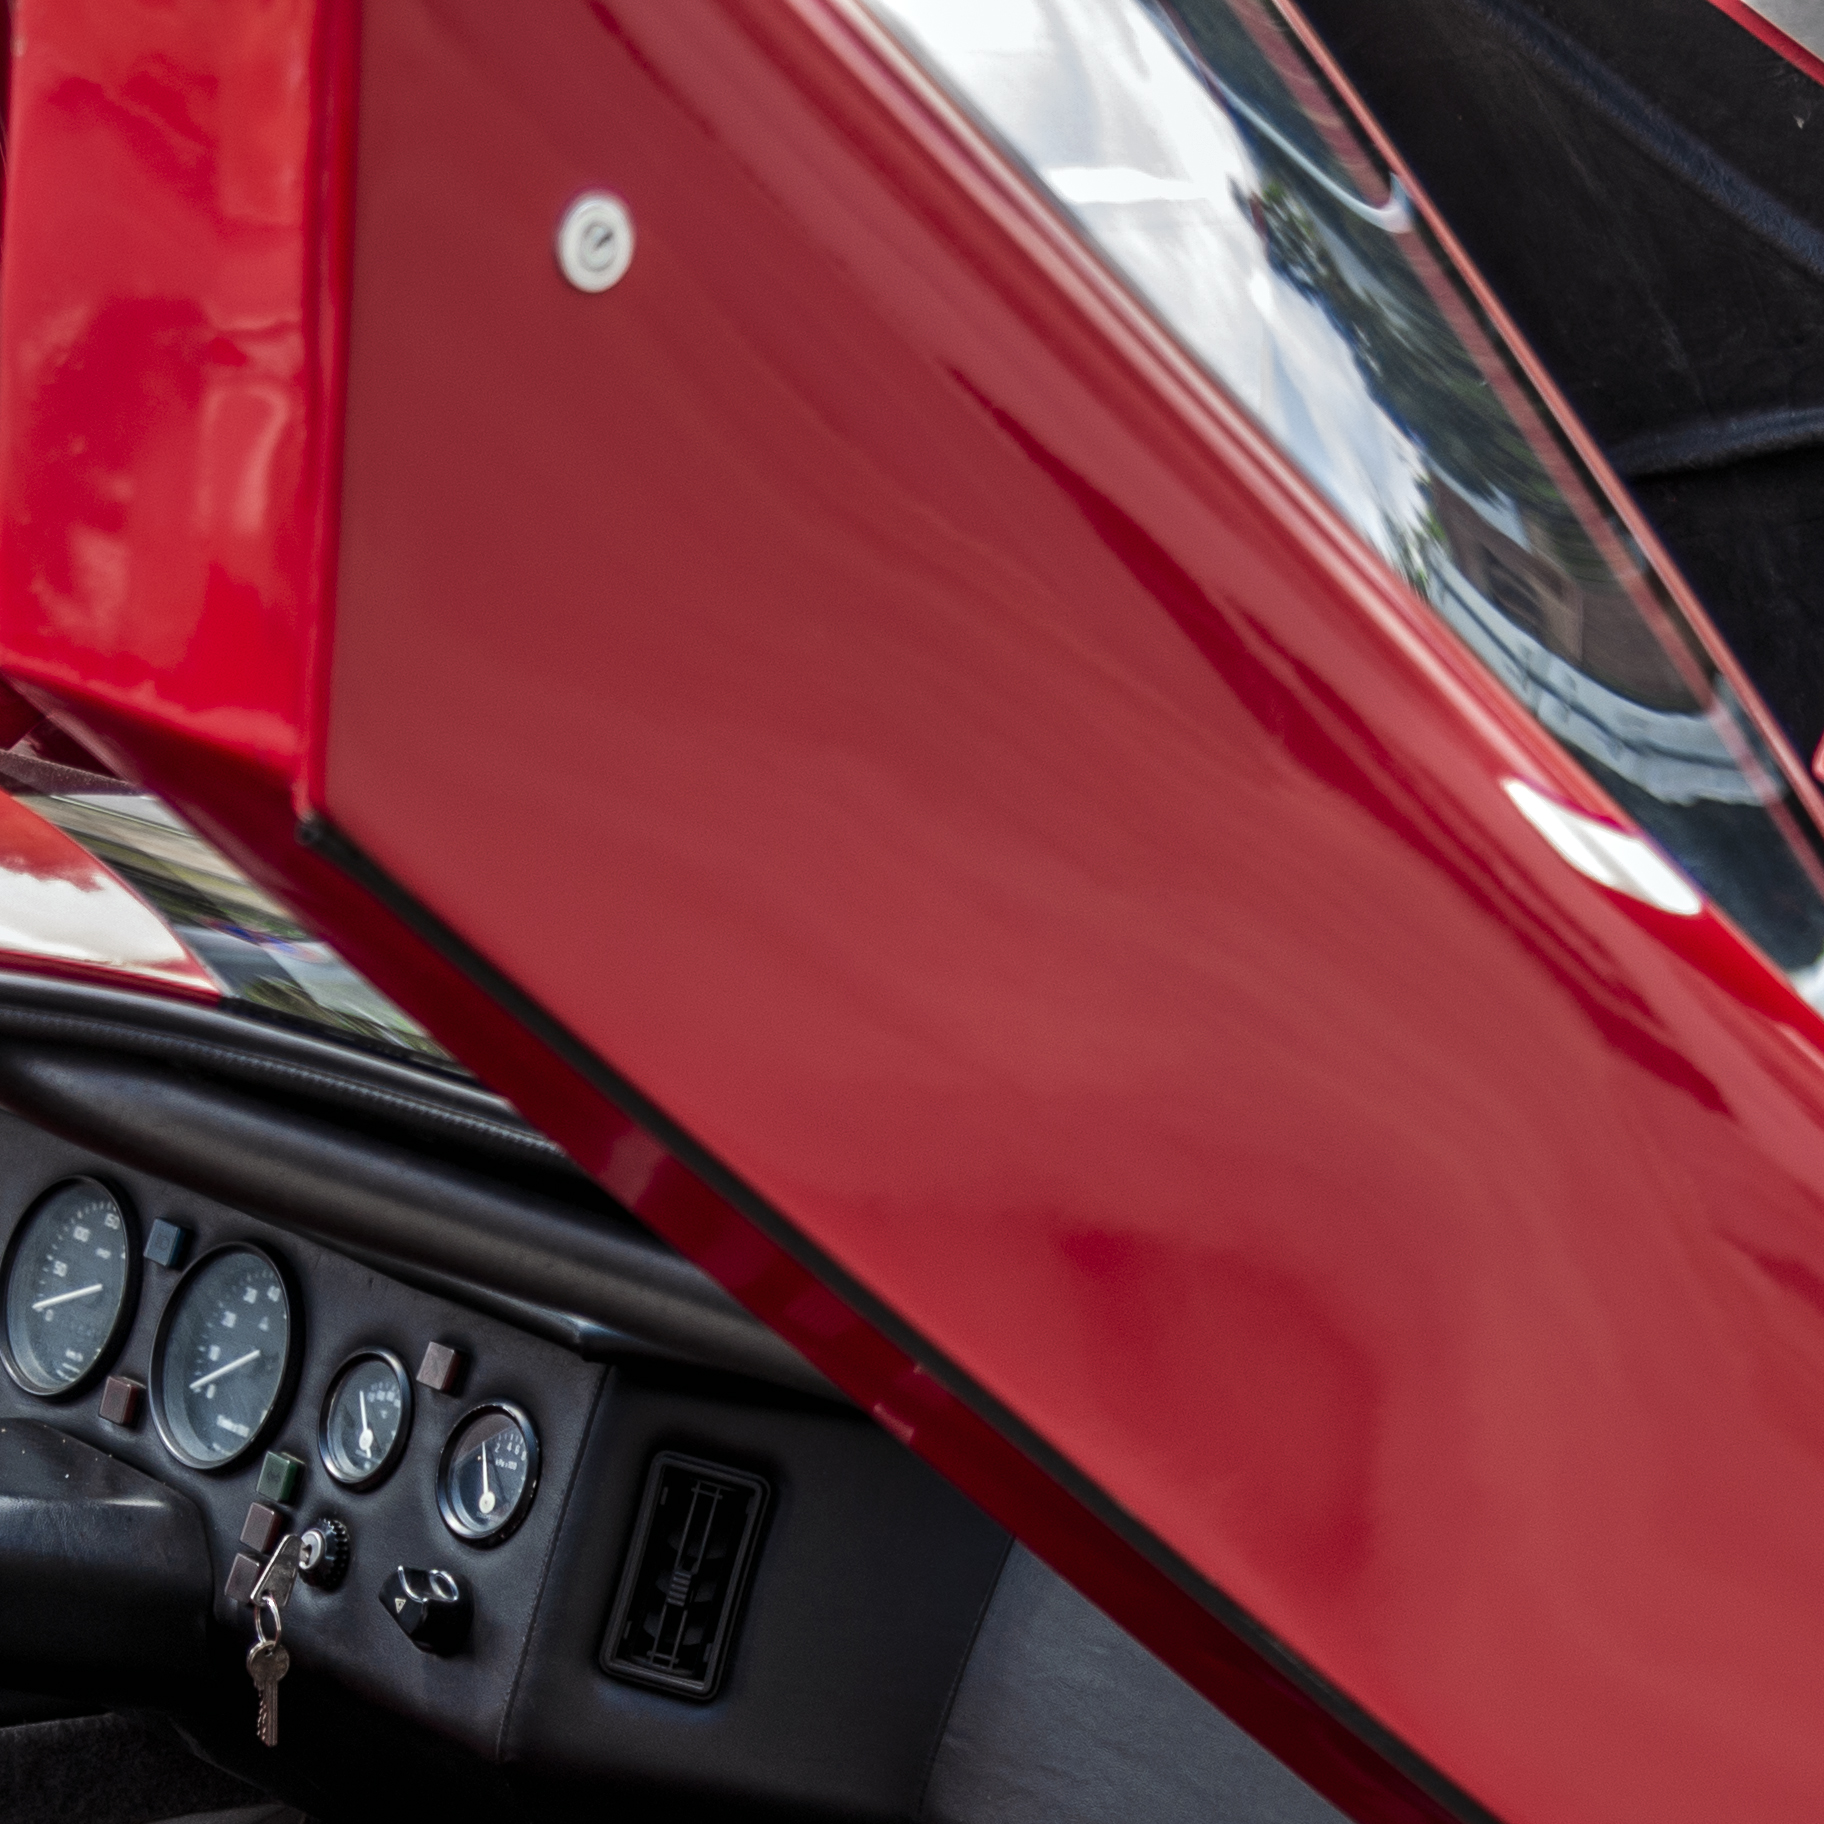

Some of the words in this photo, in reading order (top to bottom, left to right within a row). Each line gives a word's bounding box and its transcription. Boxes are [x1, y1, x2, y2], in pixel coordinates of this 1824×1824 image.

[53, 1261, 68, 1277] 50
[495, 1443, 501, 1453] 2
[507, 1442, 513, 1452] 4
[514, 1444, 521, 1455] 6
